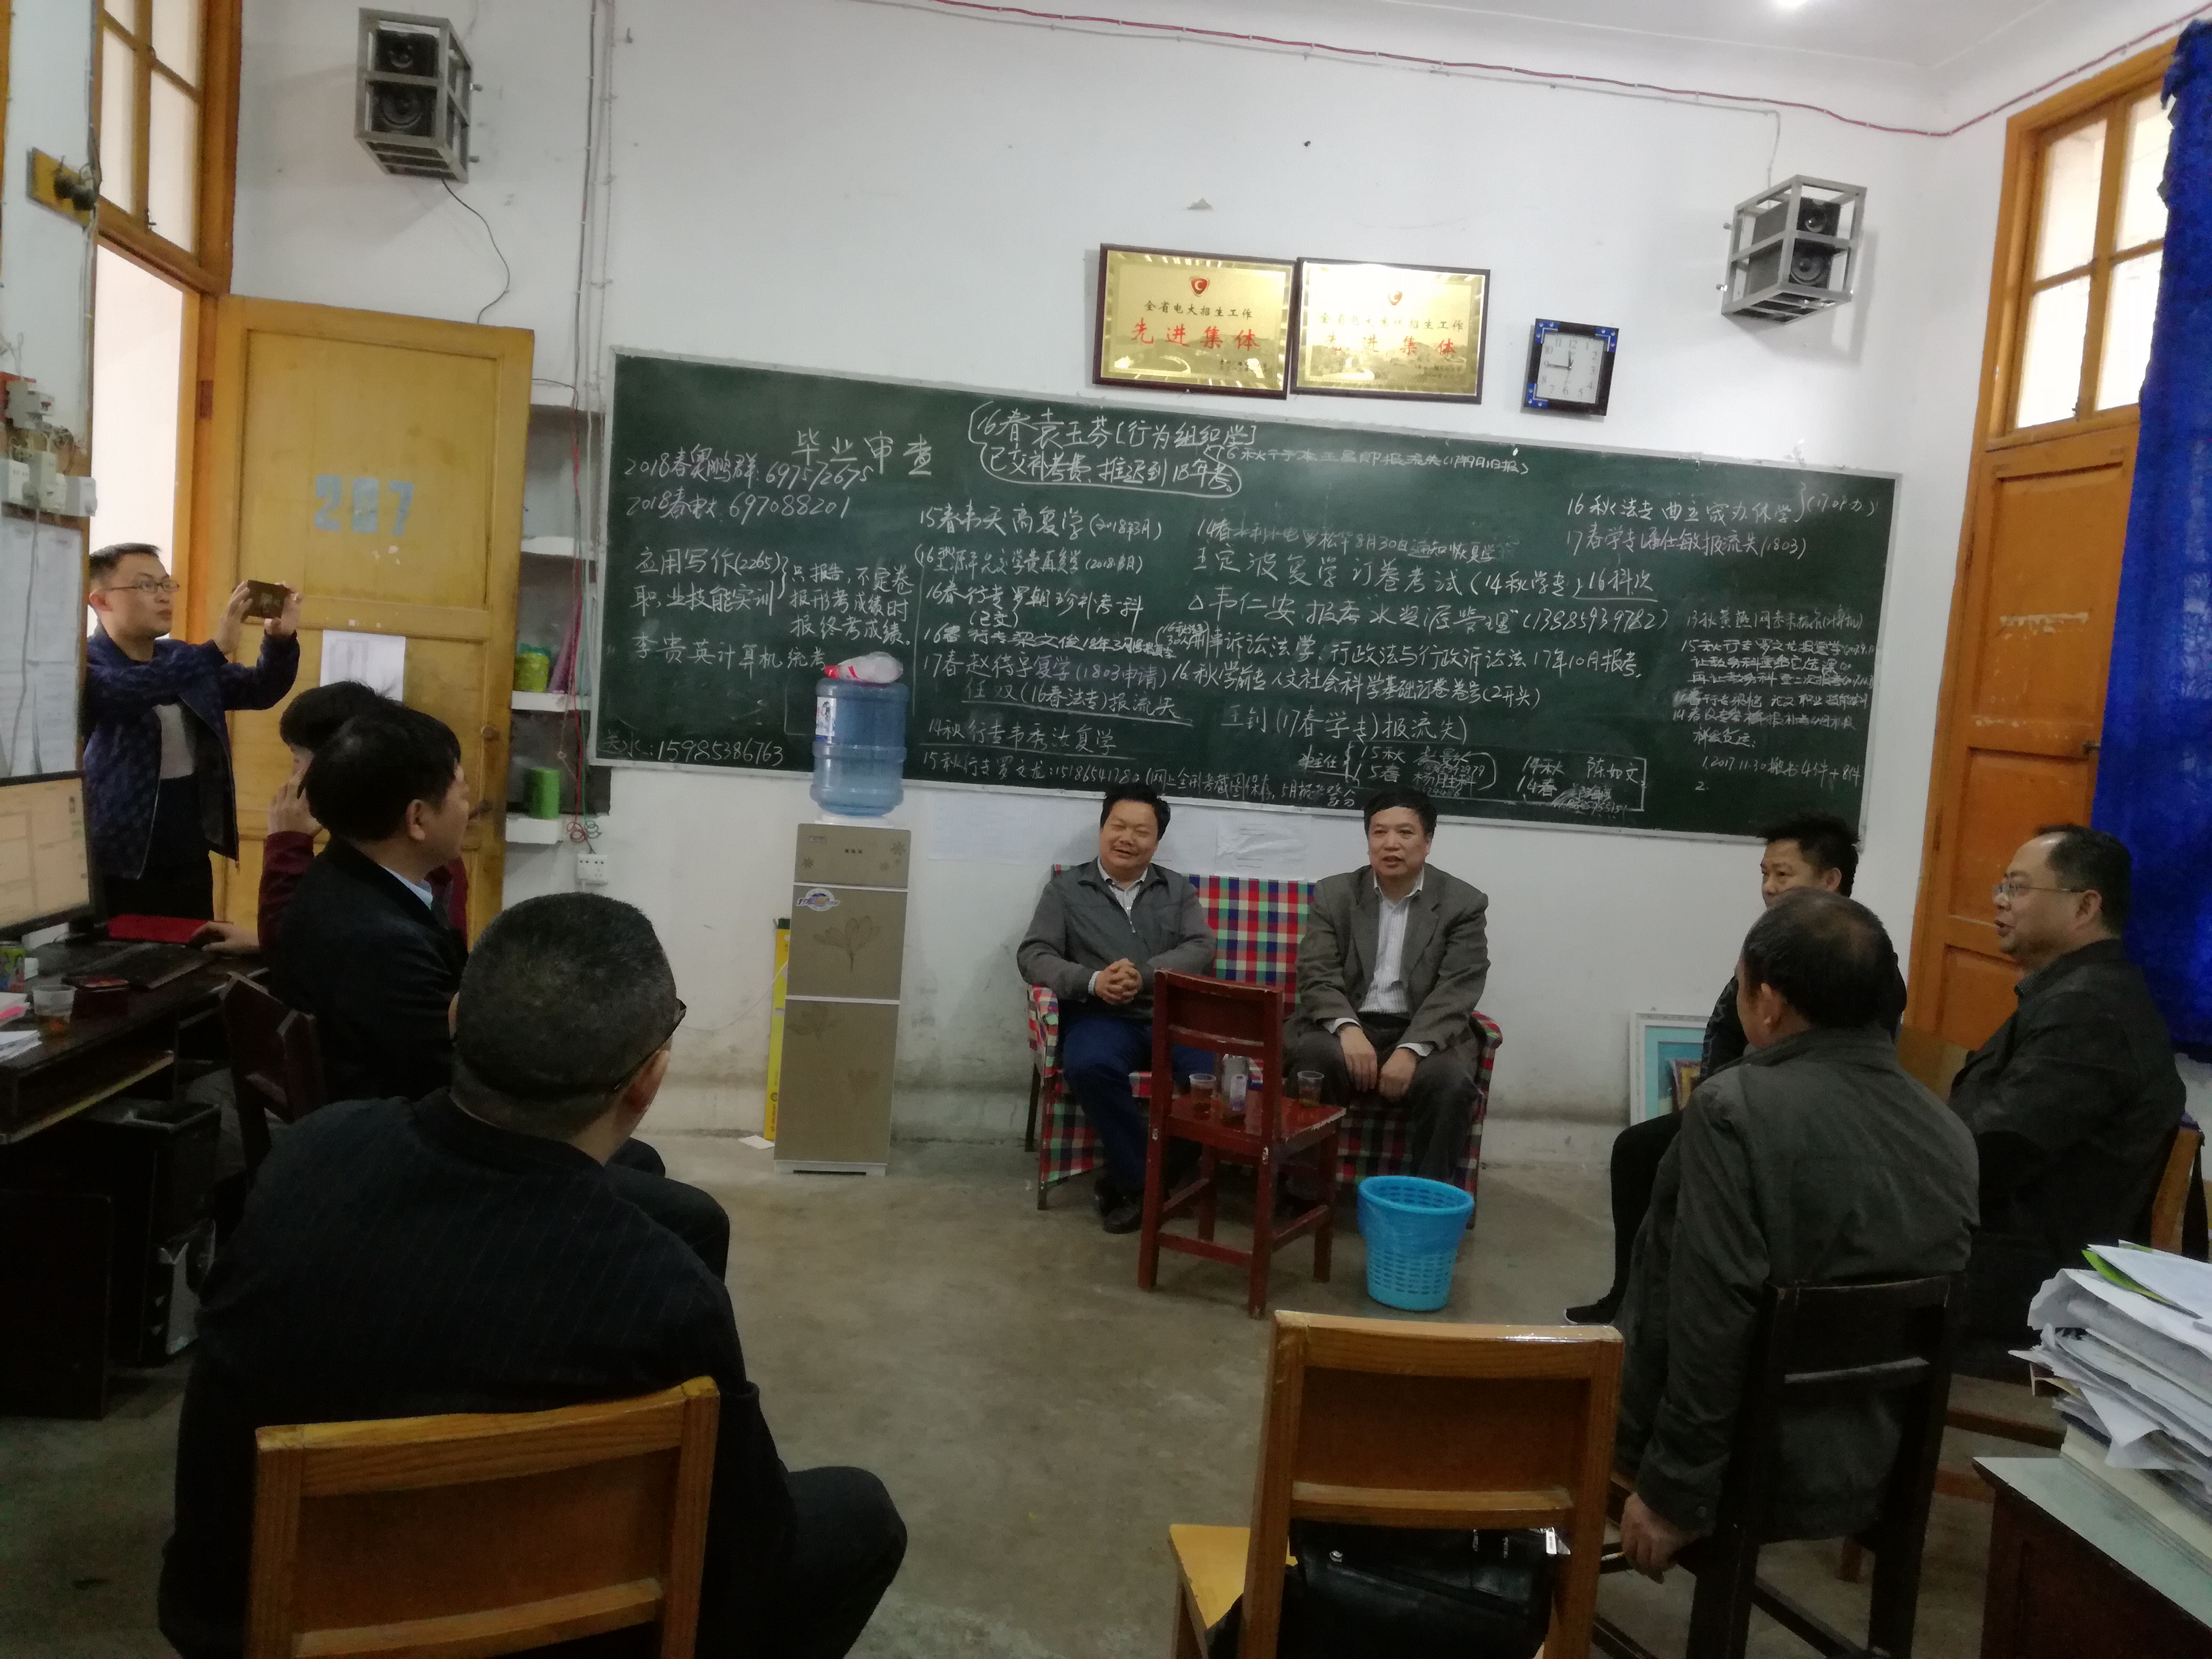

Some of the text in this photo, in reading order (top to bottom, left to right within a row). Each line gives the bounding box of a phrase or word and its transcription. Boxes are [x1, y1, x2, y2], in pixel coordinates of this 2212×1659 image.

[1144, 300, 1253, 320] 全省电大招生工作
[1132, 318, 1259, 351] 先进集体
[1569, 339, 1577, 349] 12
[1545, 346, 1553, 354] 10
[1590, 366, 1595, 374] 3
[1550, 384, 1555, 393] 7
[1563, 387, 1569, 395] 6
[1578, 388, 1583, 397] 5
[792, 428, 932, 475] 毕业审查
[635, 547, 781, 577] 应用写作(2265)
